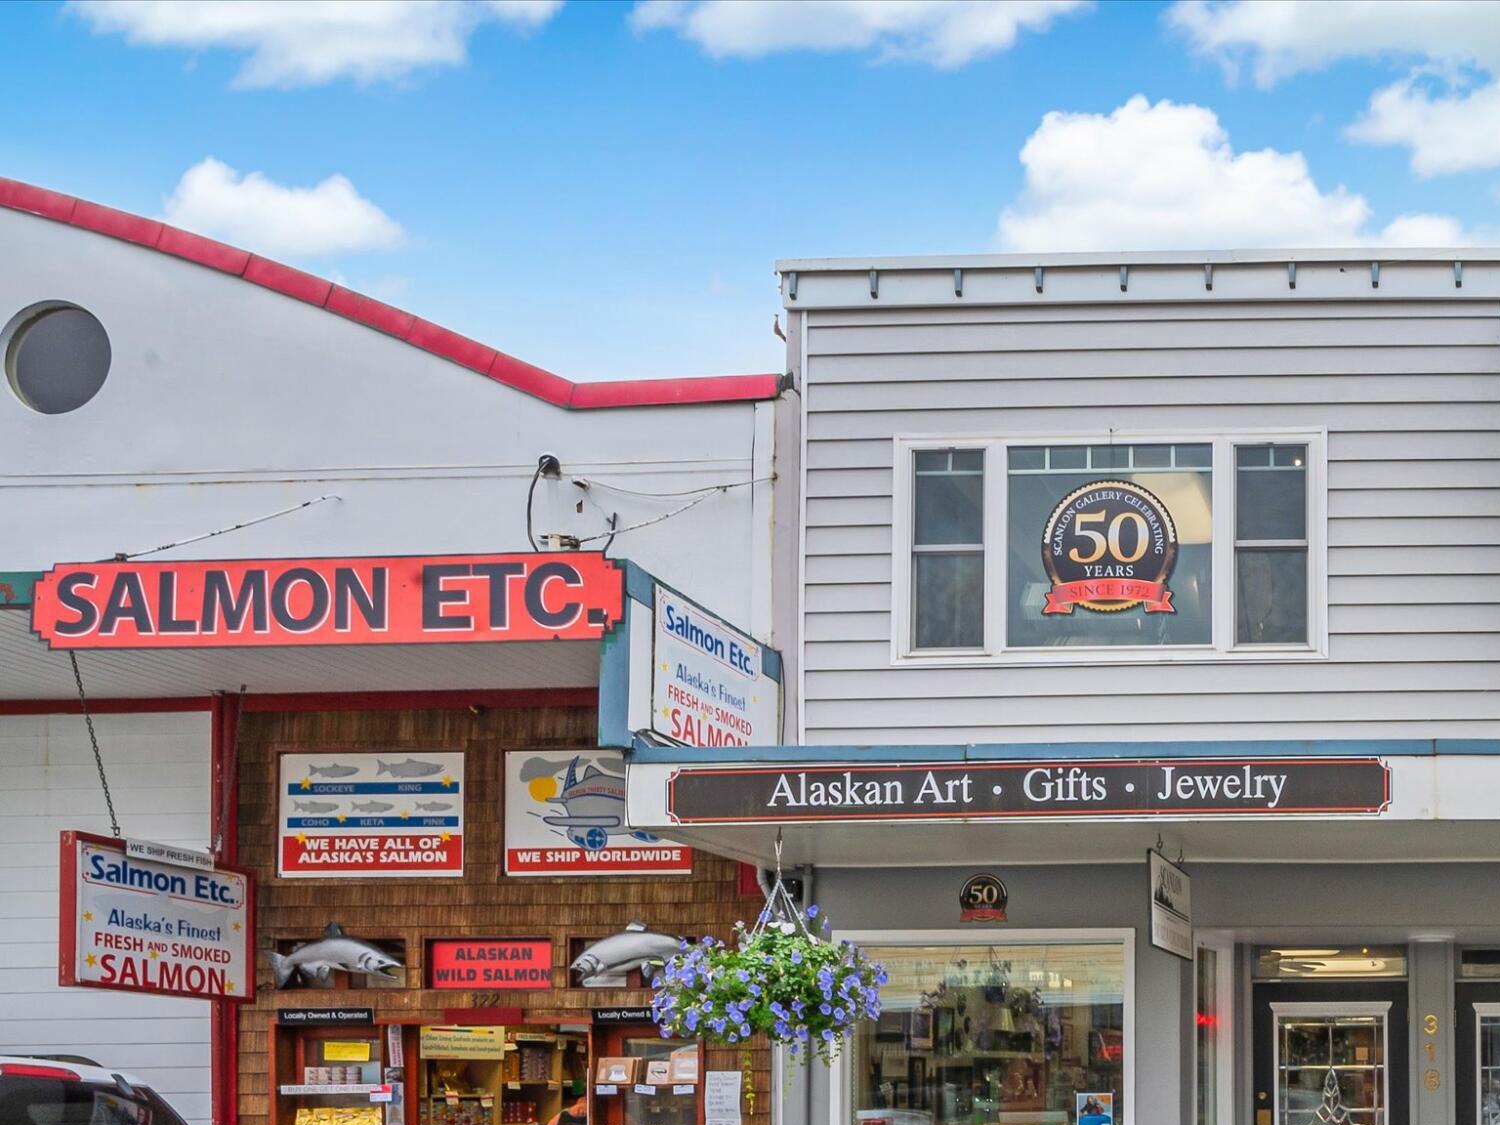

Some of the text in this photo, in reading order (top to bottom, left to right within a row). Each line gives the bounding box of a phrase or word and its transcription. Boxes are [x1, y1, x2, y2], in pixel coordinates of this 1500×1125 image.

[1053, 491, 1164, 557] SCANLON GALLERY CELEBRATING
[1069, 509, 1150, 563] 50
[1084, 565, 1134, 577] YEARS
[54, 561, 606, 637] SALMON ETC.
[1070, 584, 1150, 597] SINCE 1972
[665, 605, 754, 676] Salmon Etc.
[676, 663, 717, 698] Alaska's
[668, 684, 752, 737] FRESH AND SMOKED
[313, 783, 422, 793] SOCKEYE KING
[767, 765, 1288, 808] Alaskan Art Gifts Jewelry
[301, 817, 446, 827] COHO KETA PINK
[130, 843, 212, 866] WE SHIP FRESH FISH
[305, 838, 442, 850] WE HAVE ALL OF
[298, 851, 447, 863] ALASKA'S SALMON
[517, 850, 681, 863] WE SHIP WORLDWIDE
[90, 854, 235, 905] Salmon Etc.
[969, 885, 998, 904] 50
[108, 909, 221, 941] Alaska's Finest
[94, 932, 231, 964] FRESH AND SMOKED
[455, 947, 532, 960] ALASKAN
[100, 953, 227, 995] SALMON
[436, 968, 552, 981] WILD SALMON
[471, 992, 500, 1008] 322
[284, 1011, 368, 1020] Locally Owned & Operated
[598, 1011, 621, 1020] Locally
[622, 1011, 645, 1019] Owned
[1423, 1014, 1441, 1091] 318
